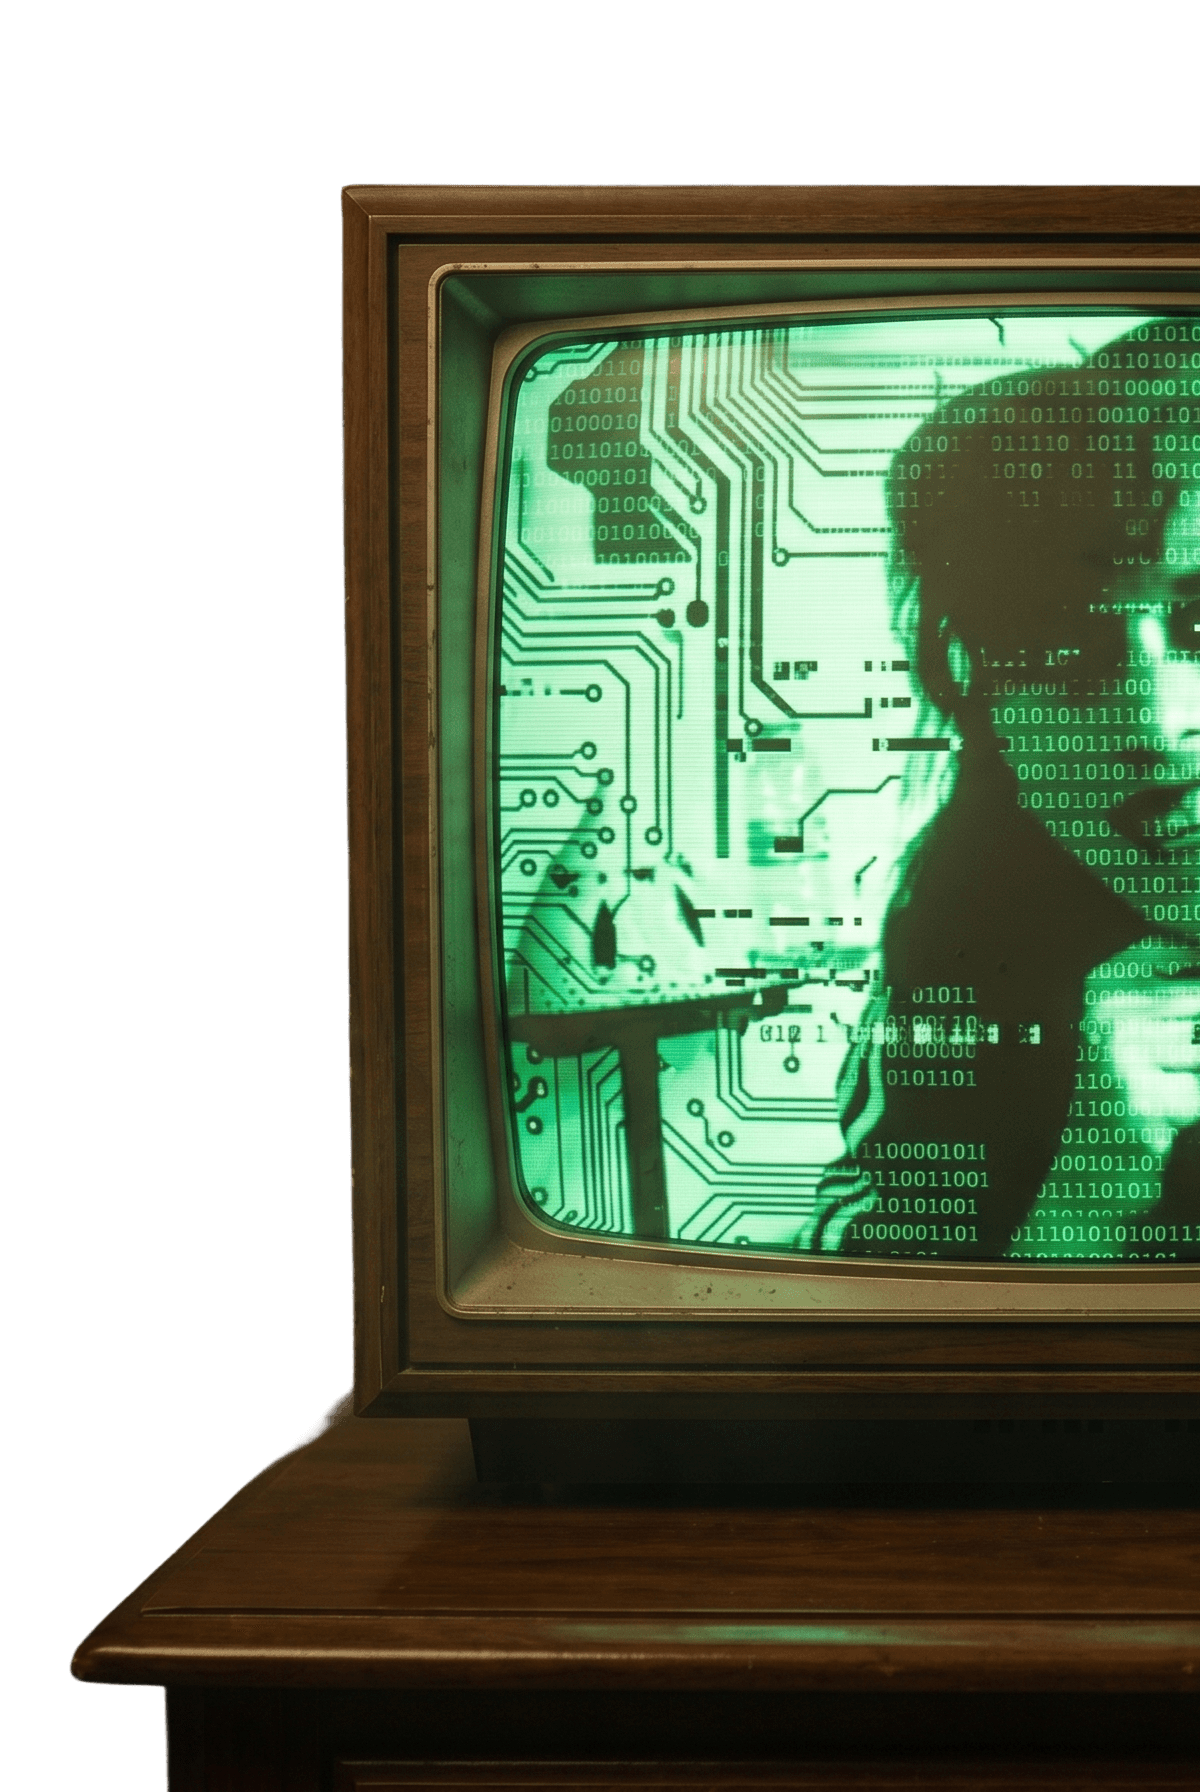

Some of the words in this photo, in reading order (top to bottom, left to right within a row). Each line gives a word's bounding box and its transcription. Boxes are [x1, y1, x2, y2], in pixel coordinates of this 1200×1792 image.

[1086, 435, 1136, 452] 1011
[1112, 463, 1137, 480] 11
[886, 1070, 978, 1087] 0101101
[850, 1224, 979, 1242] 1000001101
